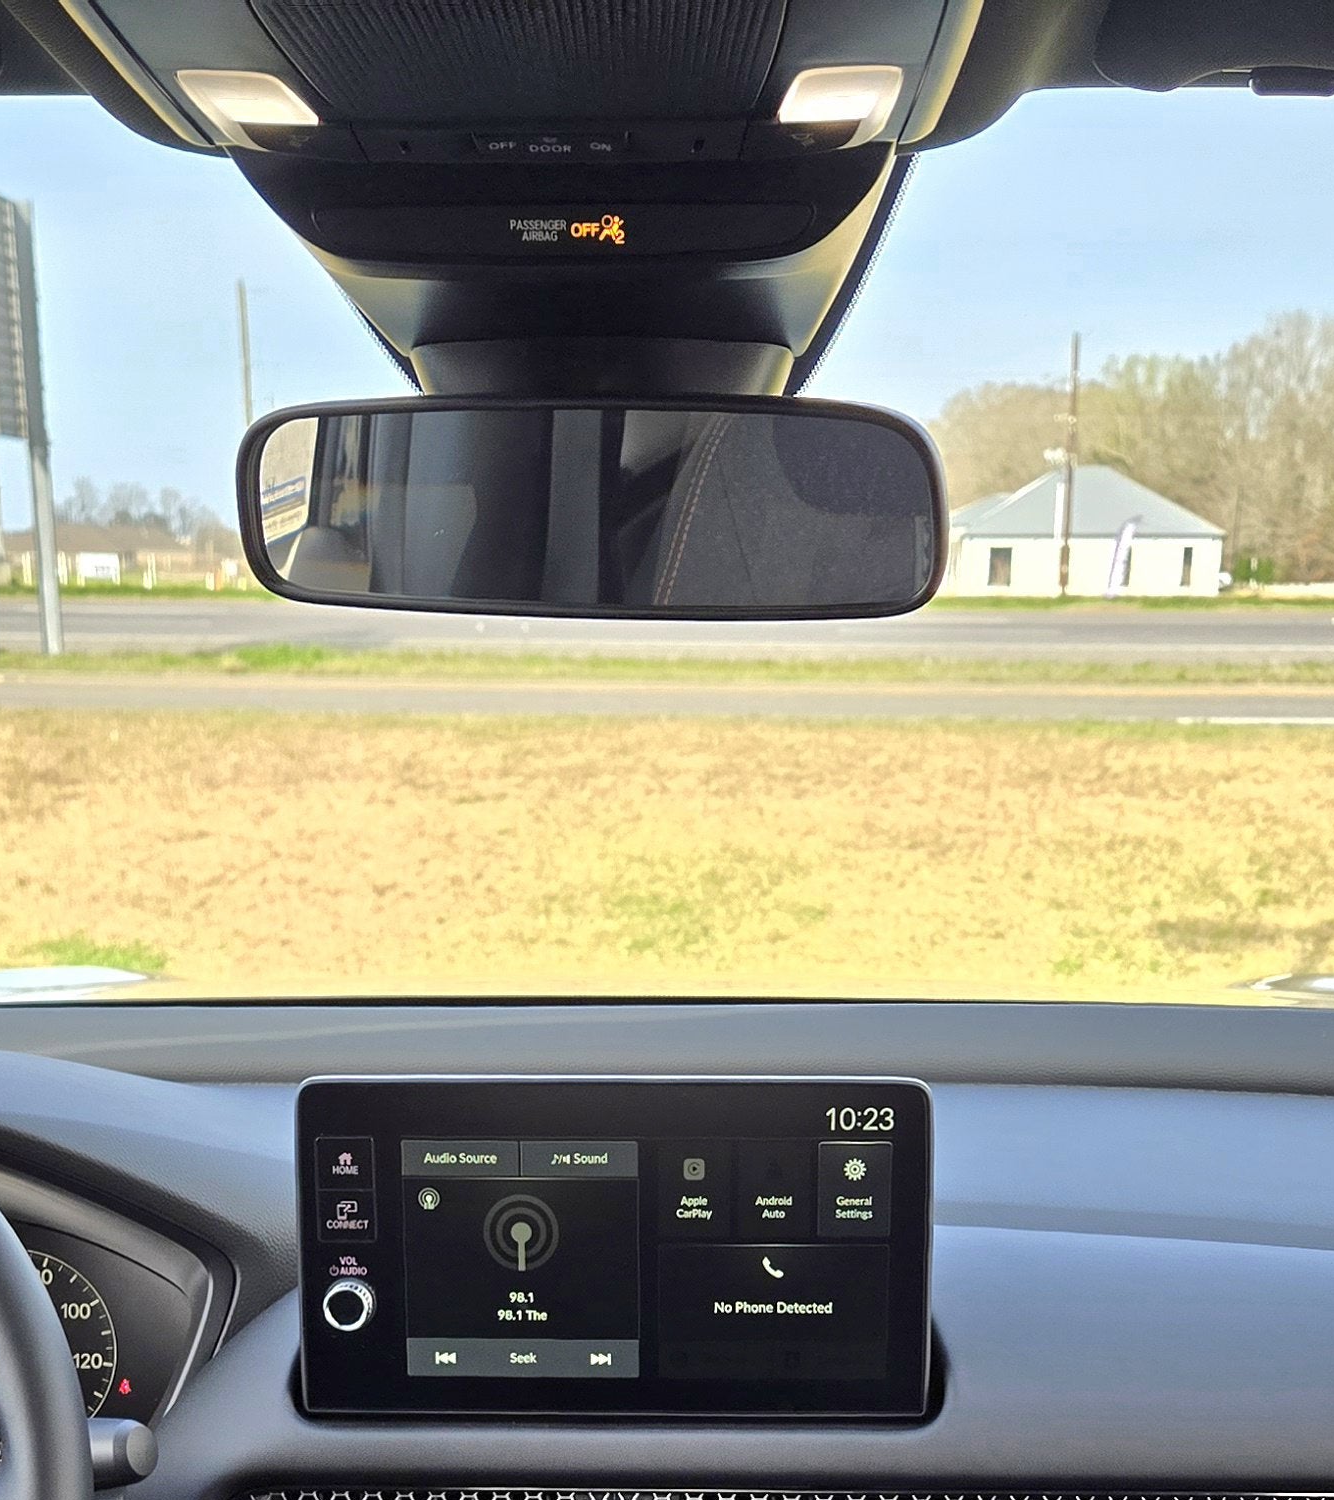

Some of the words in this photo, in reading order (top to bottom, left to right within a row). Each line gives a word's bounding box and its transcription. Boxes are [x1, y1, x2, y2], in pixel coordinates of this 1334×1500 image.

[529, 144, 571, 152] DOOR
[589, 142, 612, 151] ON
[510, 219, 566, 231] PASSENGER
[570, 222, 600, 238] OFF
[522, 230, 558, 241] AIRBAG
[825, 1107, 895, 1132] 10:23
[423, 1152, 456, 1165] Audio
[459, 1152, 498, 1165] Source
[573, 1152, 608, 1165] Sound
[332, 1165, 359, 1176] HOME
[680, 1196, 708, 1208] Apple
[755, 1196, 793, 1207] Android
[836, 1196, 872, 1207] General
[676, 1208, 713, 1221] CarPlay
[762, 1208, 786, 1219] Auto
[835, 1208, 873, 1221] Settings
[326, 1219, 369, 1231] CONNECT
[339, 1256, 358, 1267] VOL
[340, 1265, 368, 1277] AUDIO
[509, 1291, 535, 1304] 98.1
[60, 1302, 92, 1320] 100
[714, 1302, 733, 1314] No
[735, 1302, 774, 1314] Phone
[777, 1302, 833, 1314] Detected
[497, 1309, 523, 1322] 98.1
[525, 1309, 548, 1322] The
[73, 1353, 103, 1370] 120
[510, 1352, 538, 1365] Seek
